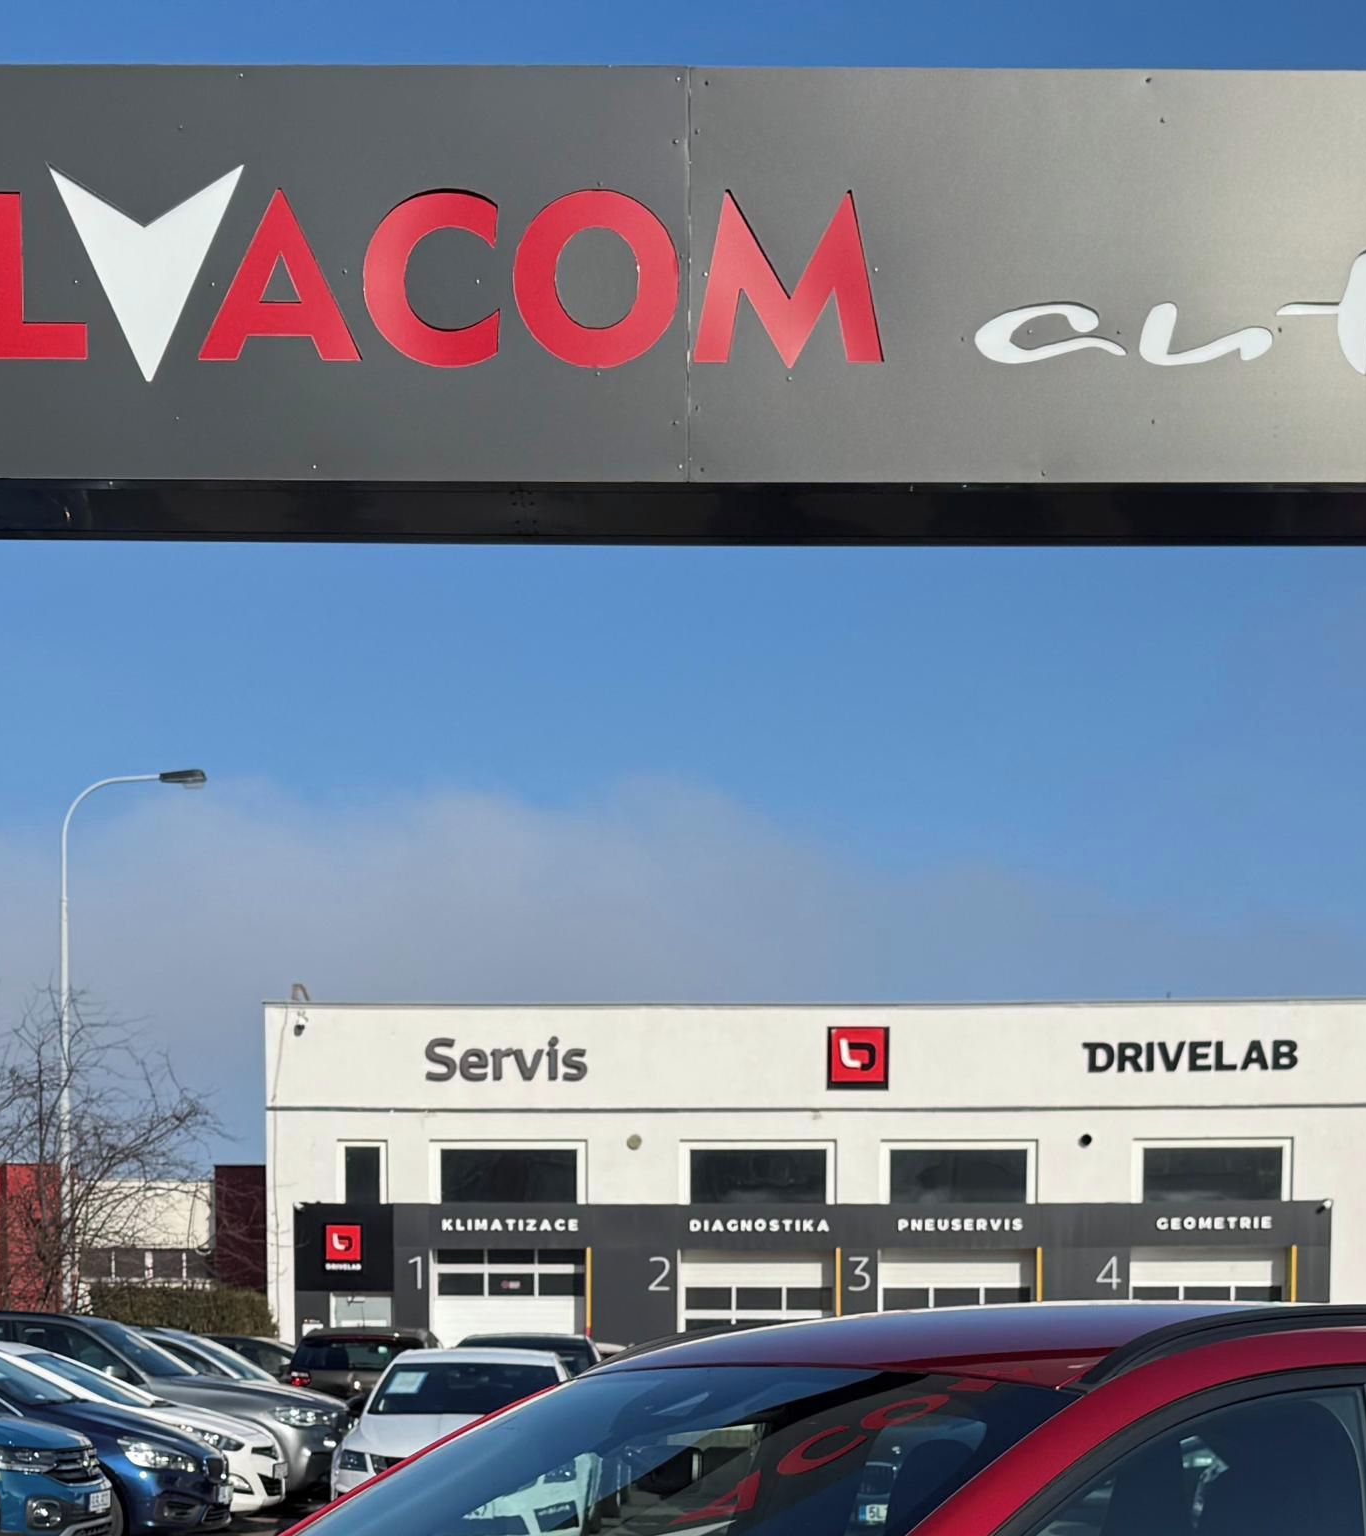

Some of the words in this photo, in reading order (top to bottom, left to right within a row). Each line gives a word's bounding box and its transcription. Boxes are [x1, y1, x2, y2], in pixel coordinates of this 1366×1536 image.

[425, 1036, 588, 1082] Servis
[1082, 1040, 1298, 1073] DRIVELAB
[441, 1218, 579, 1232] KLIMATIZACE
[689, 1218, 830, 1232] DIAGNOSTIKA
[897, 1218, 1024, 1232] PNEUSERVIS
[1155, 1216, 1273, 1230] GEOMETRIE
[408, 1256, 422, 1290] 1
[648, 1256, 671, 1291] 2
[848, 1256, 871, 1291] 3
[1096, 1255, 1122, 1290] 4
